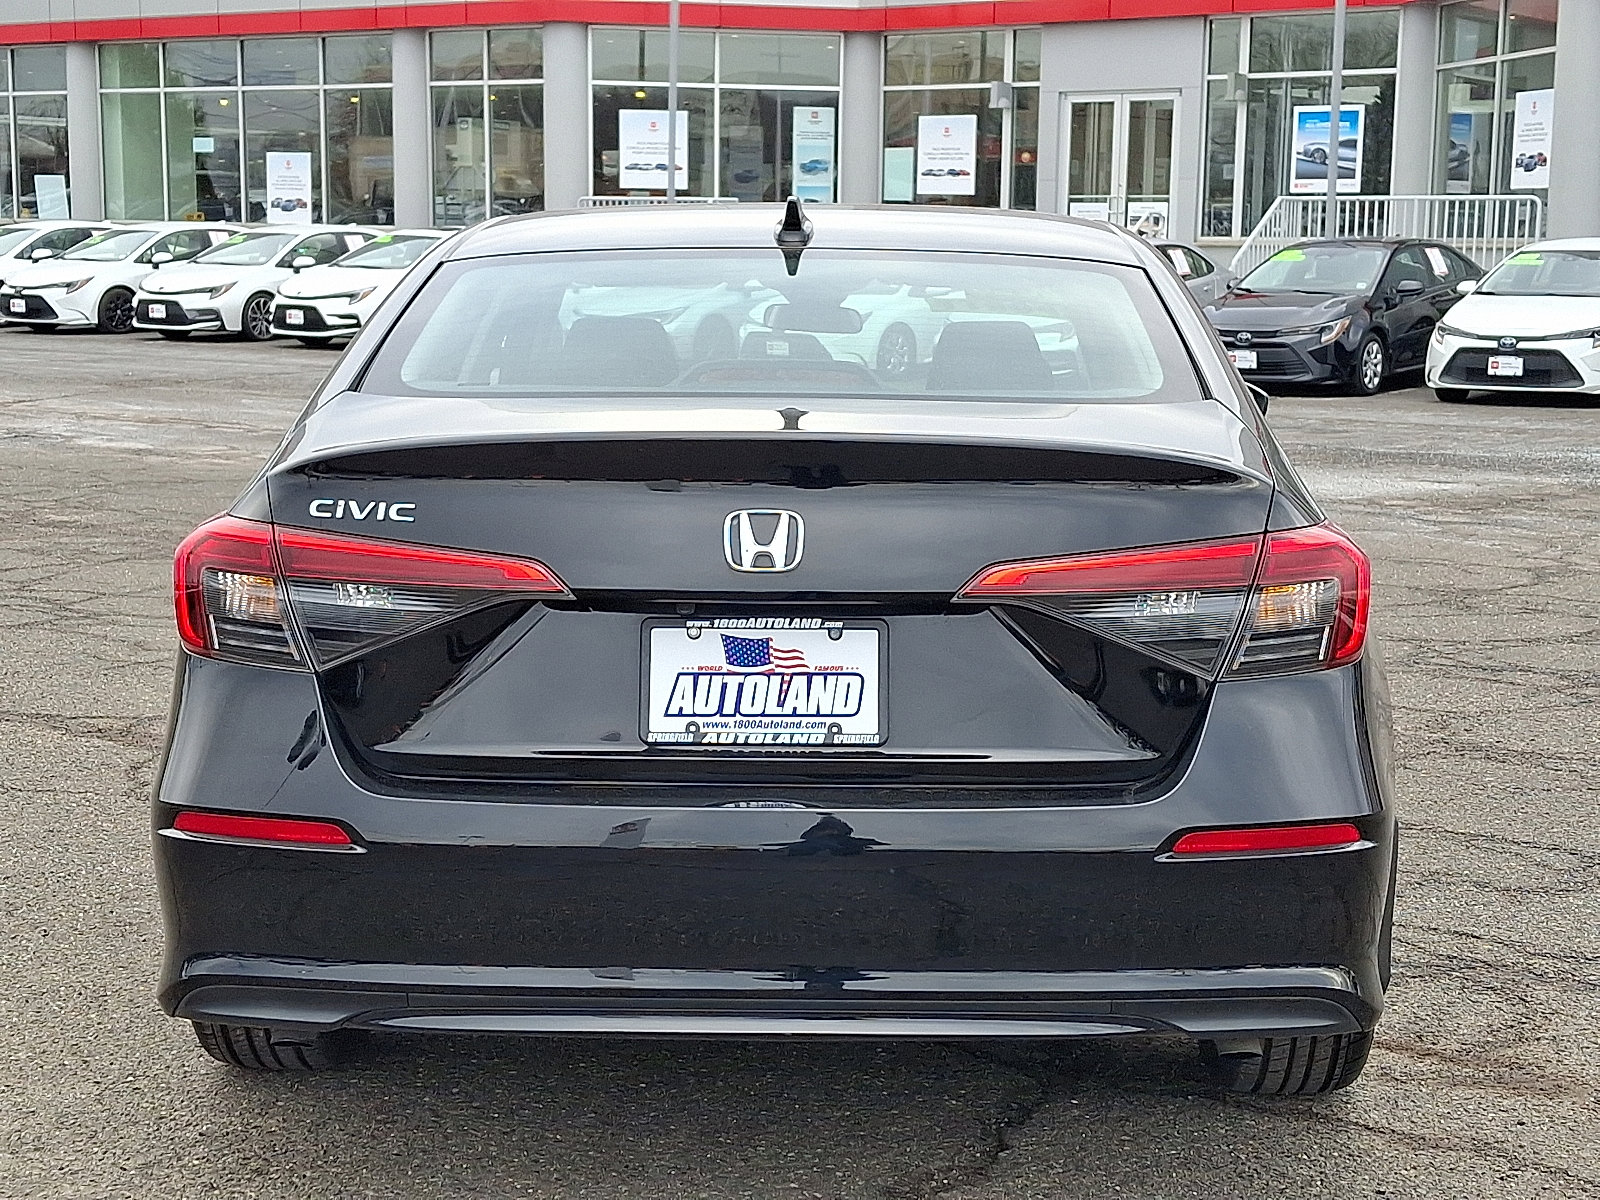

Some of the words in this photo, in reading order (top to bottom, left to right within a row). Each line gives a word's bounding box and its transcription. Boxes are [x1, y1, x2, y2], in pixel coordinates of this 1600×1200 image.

[308, 498, 417, 522] CIVIC
[664, 672, 865, 717] AUTOLAND
[702, 719, 827, 731] www.1800Autoland.com
[701, 732, 826, 744] AUTOLAND
